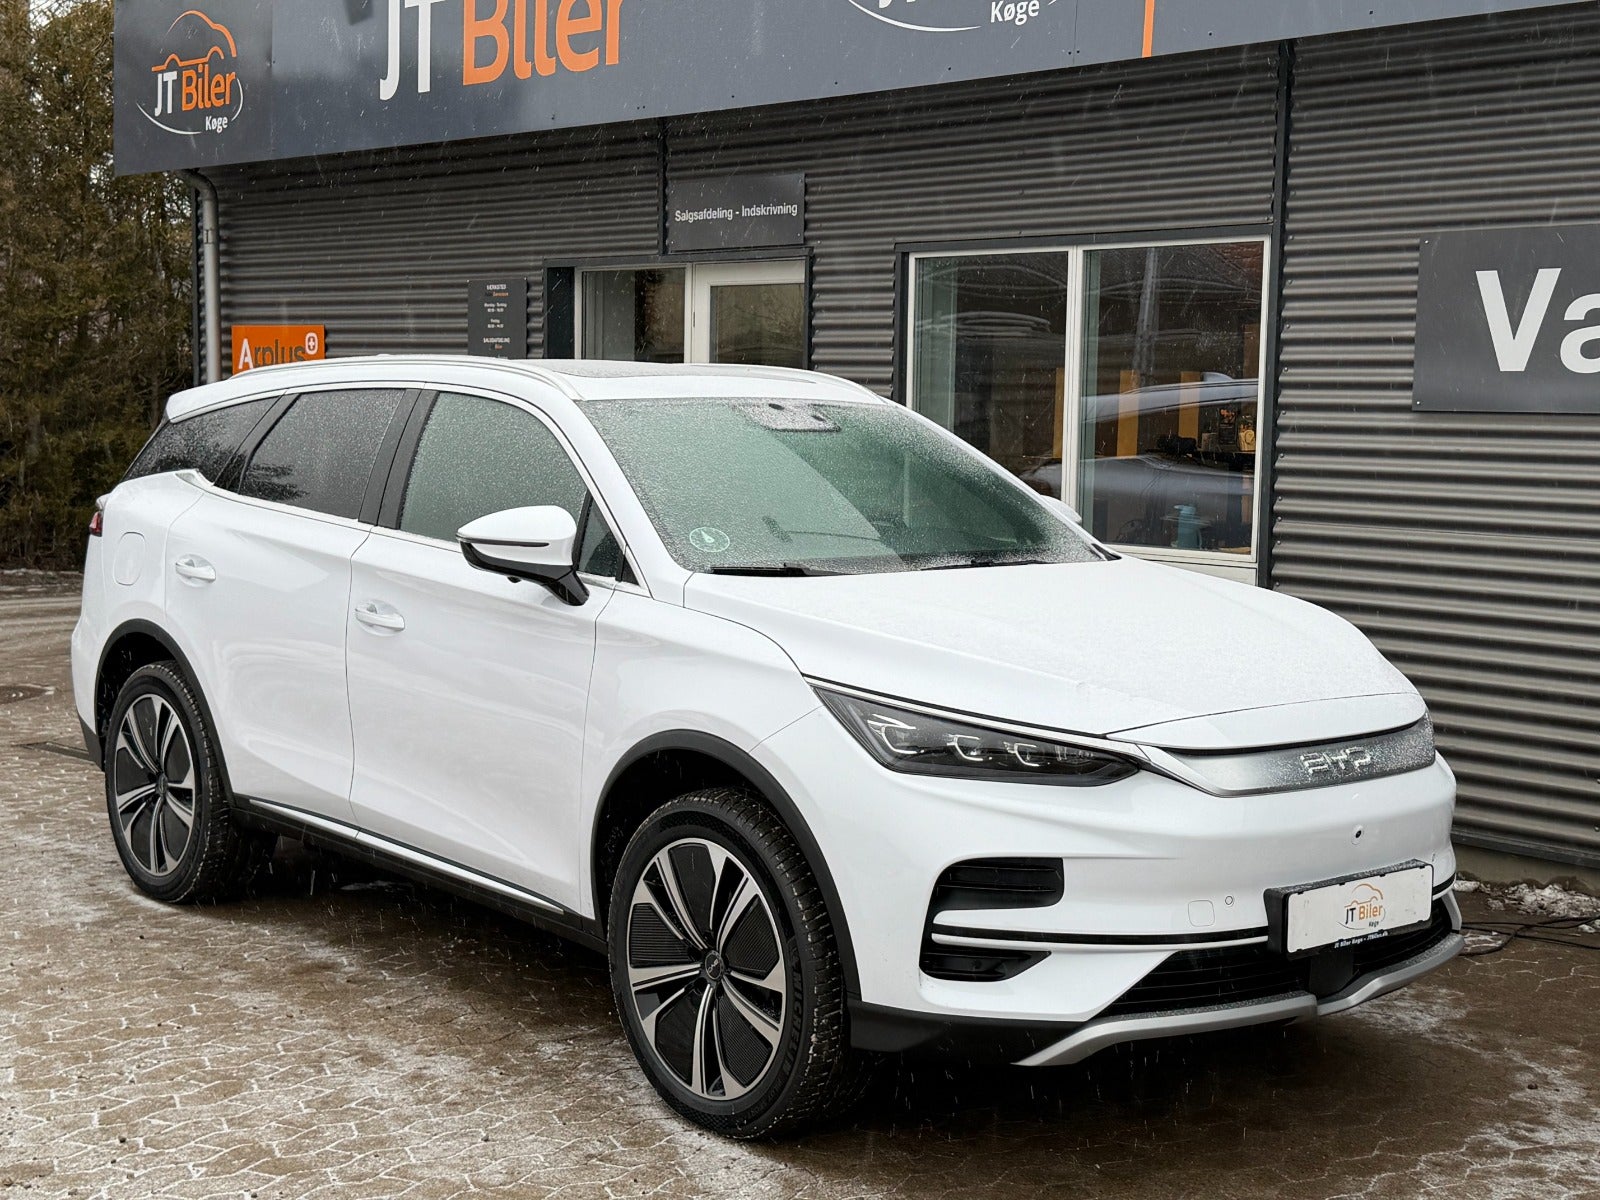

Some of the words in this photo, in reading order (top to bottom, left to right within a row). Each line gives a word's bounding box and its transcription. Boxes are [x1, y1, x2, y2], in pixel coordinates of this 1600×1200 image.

[990, 0, 1040, 26] Køge
[380, 0, 446, 100] JT
[463, 0, 624, 85] Biler
[154, 71, 178, 117] JT
[182, 63, 236, 111] Biler
[205, 115, 229, 133] Køge
[675, 207, 733, 223] Salgsafdeling
[741, 202, 798, 217] Indskrivning
[1475, 267, 1600, 374] Va
[1345, 907, 1357, 925] JT
[1359, 903, 1383, 921] Biler
